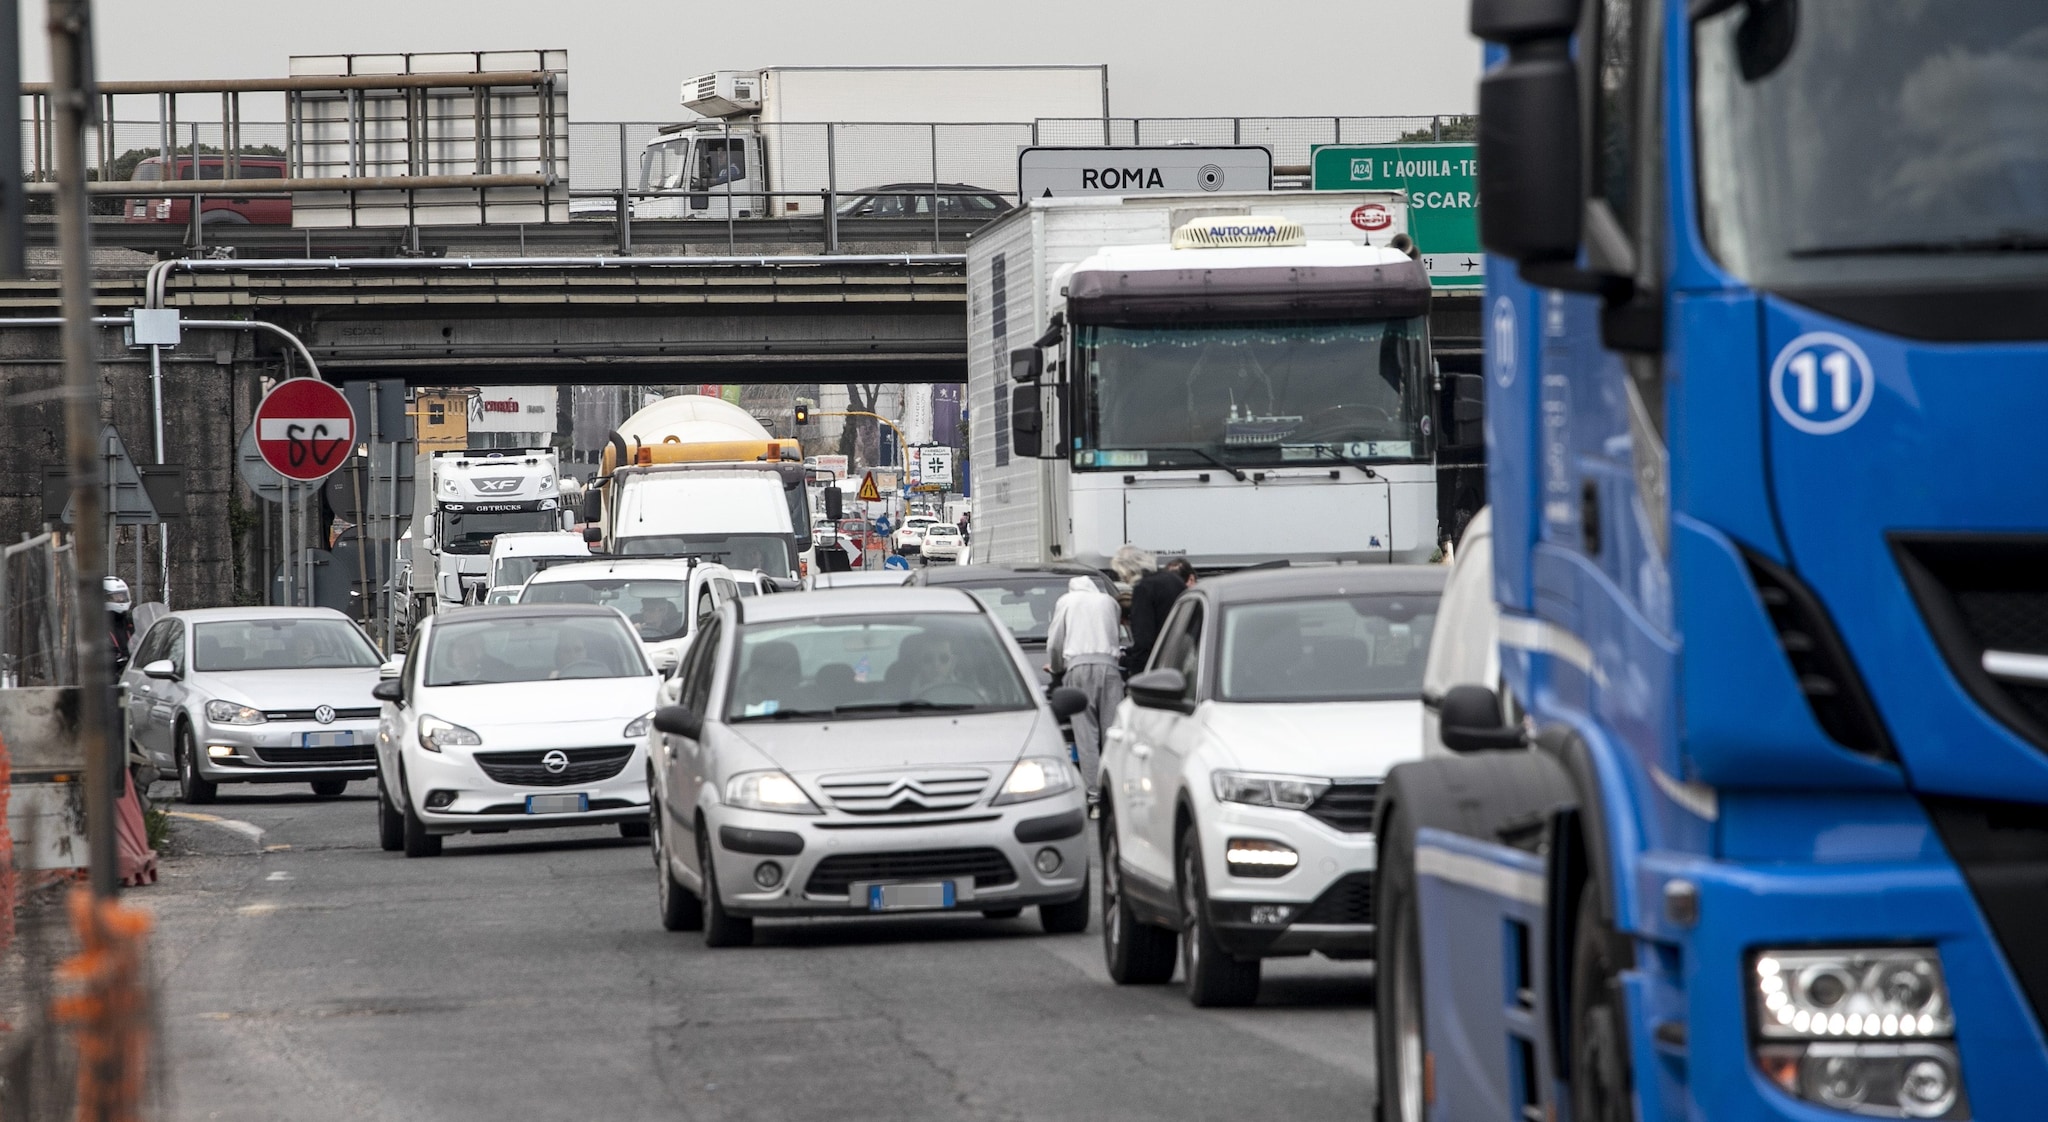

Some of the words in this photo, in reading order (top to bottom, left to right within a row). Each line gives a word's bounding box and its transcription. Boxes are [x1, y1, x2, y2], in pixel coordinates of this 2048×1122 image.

[1353, 164, 1370, 175] A24
[1082, 168, 1164, 189] ROMA
[1209, 225, 1277, 237] AUTOCLIMA
[1788, 350, 1851, 413] 11
[481, 480, 516, 491] XF
